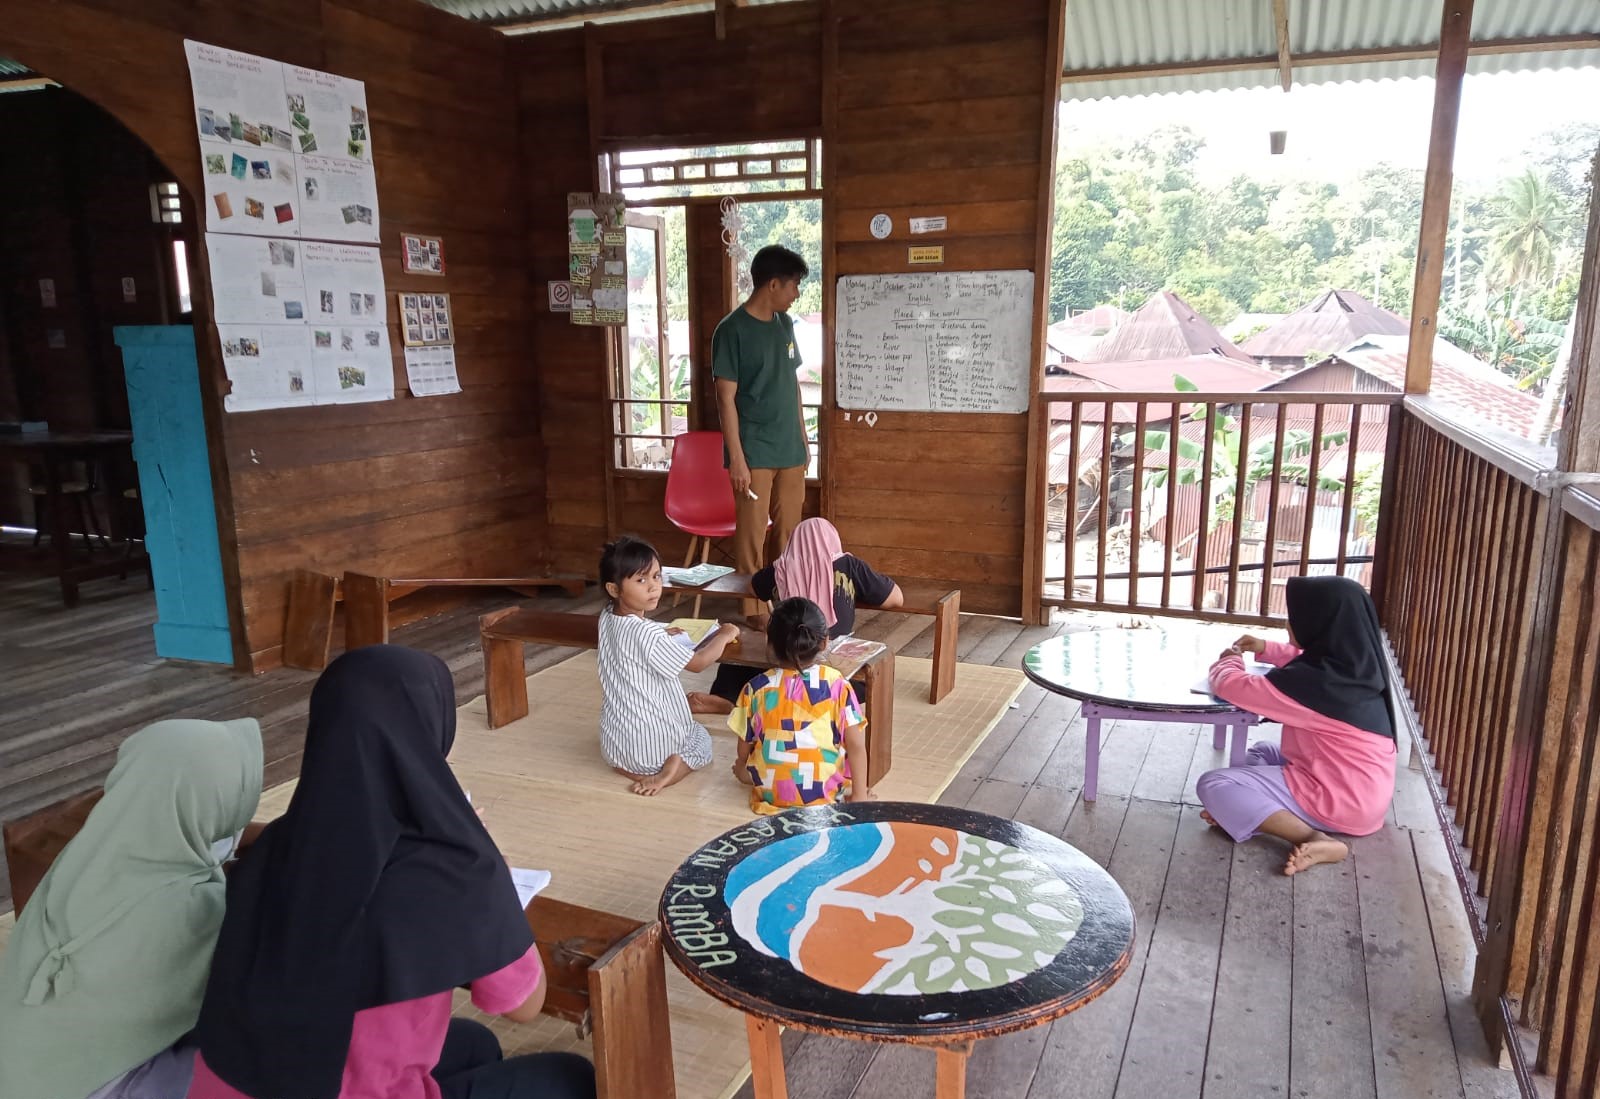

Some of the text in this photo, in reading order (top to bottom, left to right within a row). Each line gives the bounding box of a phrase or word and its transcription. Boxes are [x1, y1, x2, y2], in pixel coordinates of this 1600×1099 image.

[929, 309, 940, 318] the
[942, 308, 960, 317] world
[883, 343, 900, 351] River
[666, 804, 856, 969] YYASAN RIMBA
